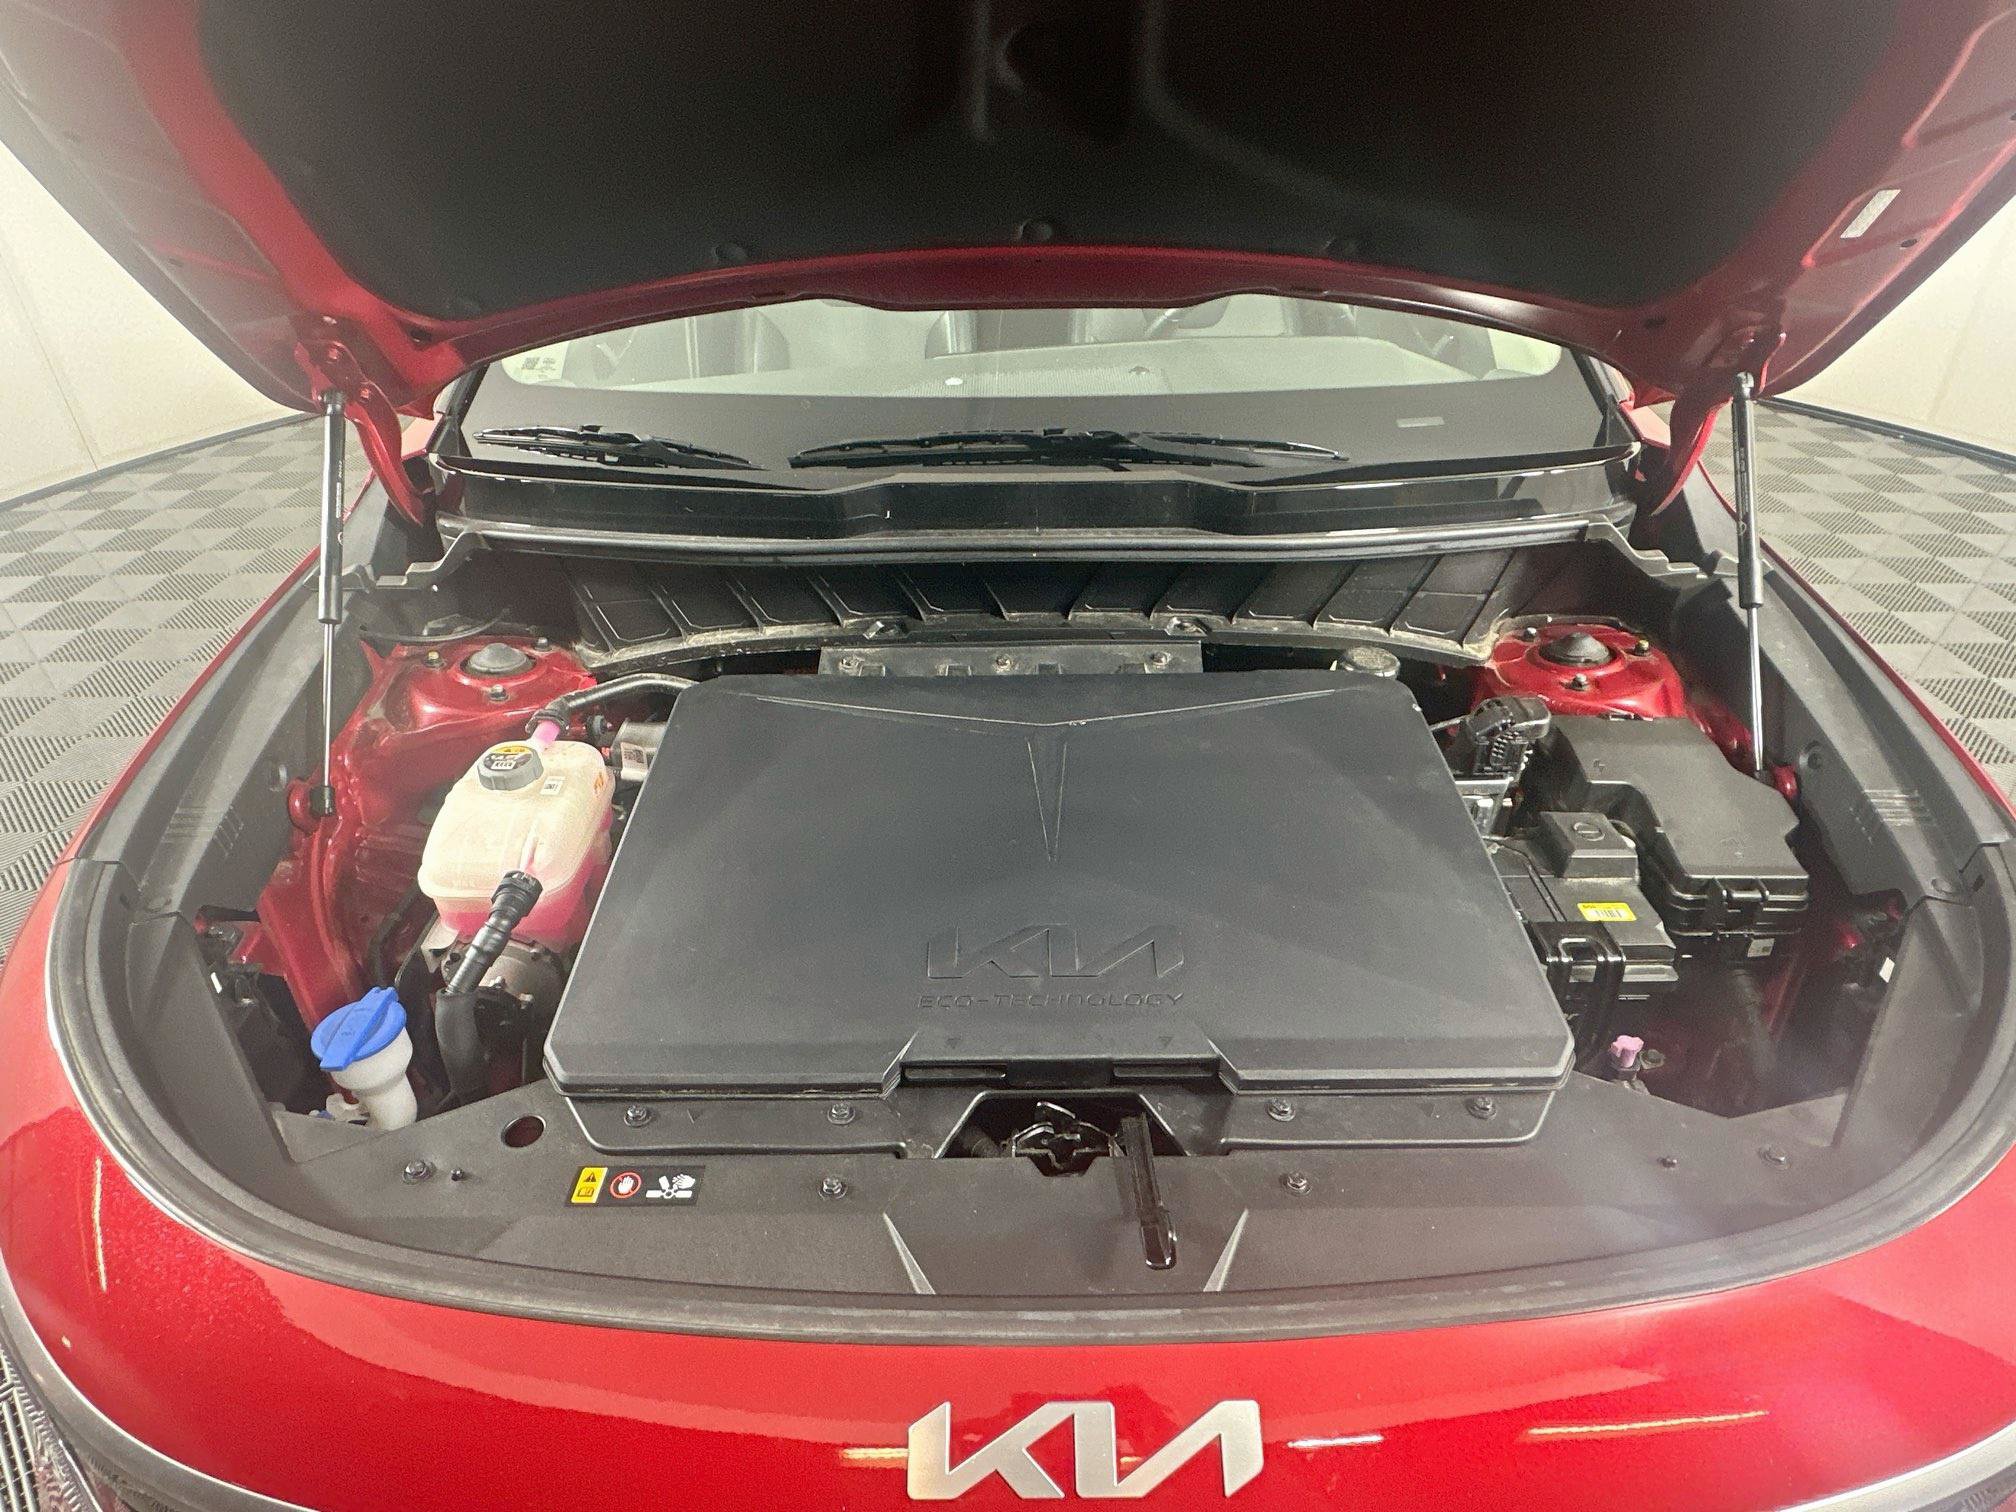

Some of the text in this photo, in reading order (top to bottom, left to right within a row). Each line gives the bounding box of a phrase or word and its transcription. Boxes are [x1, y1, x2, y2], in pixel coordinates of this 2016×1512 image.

[925, 923, 1185, 979] KIA
[917, 992, 1185, 1009] ECO-TECHNOLOGY
[907, 1400, 1265, 1500] KIA
